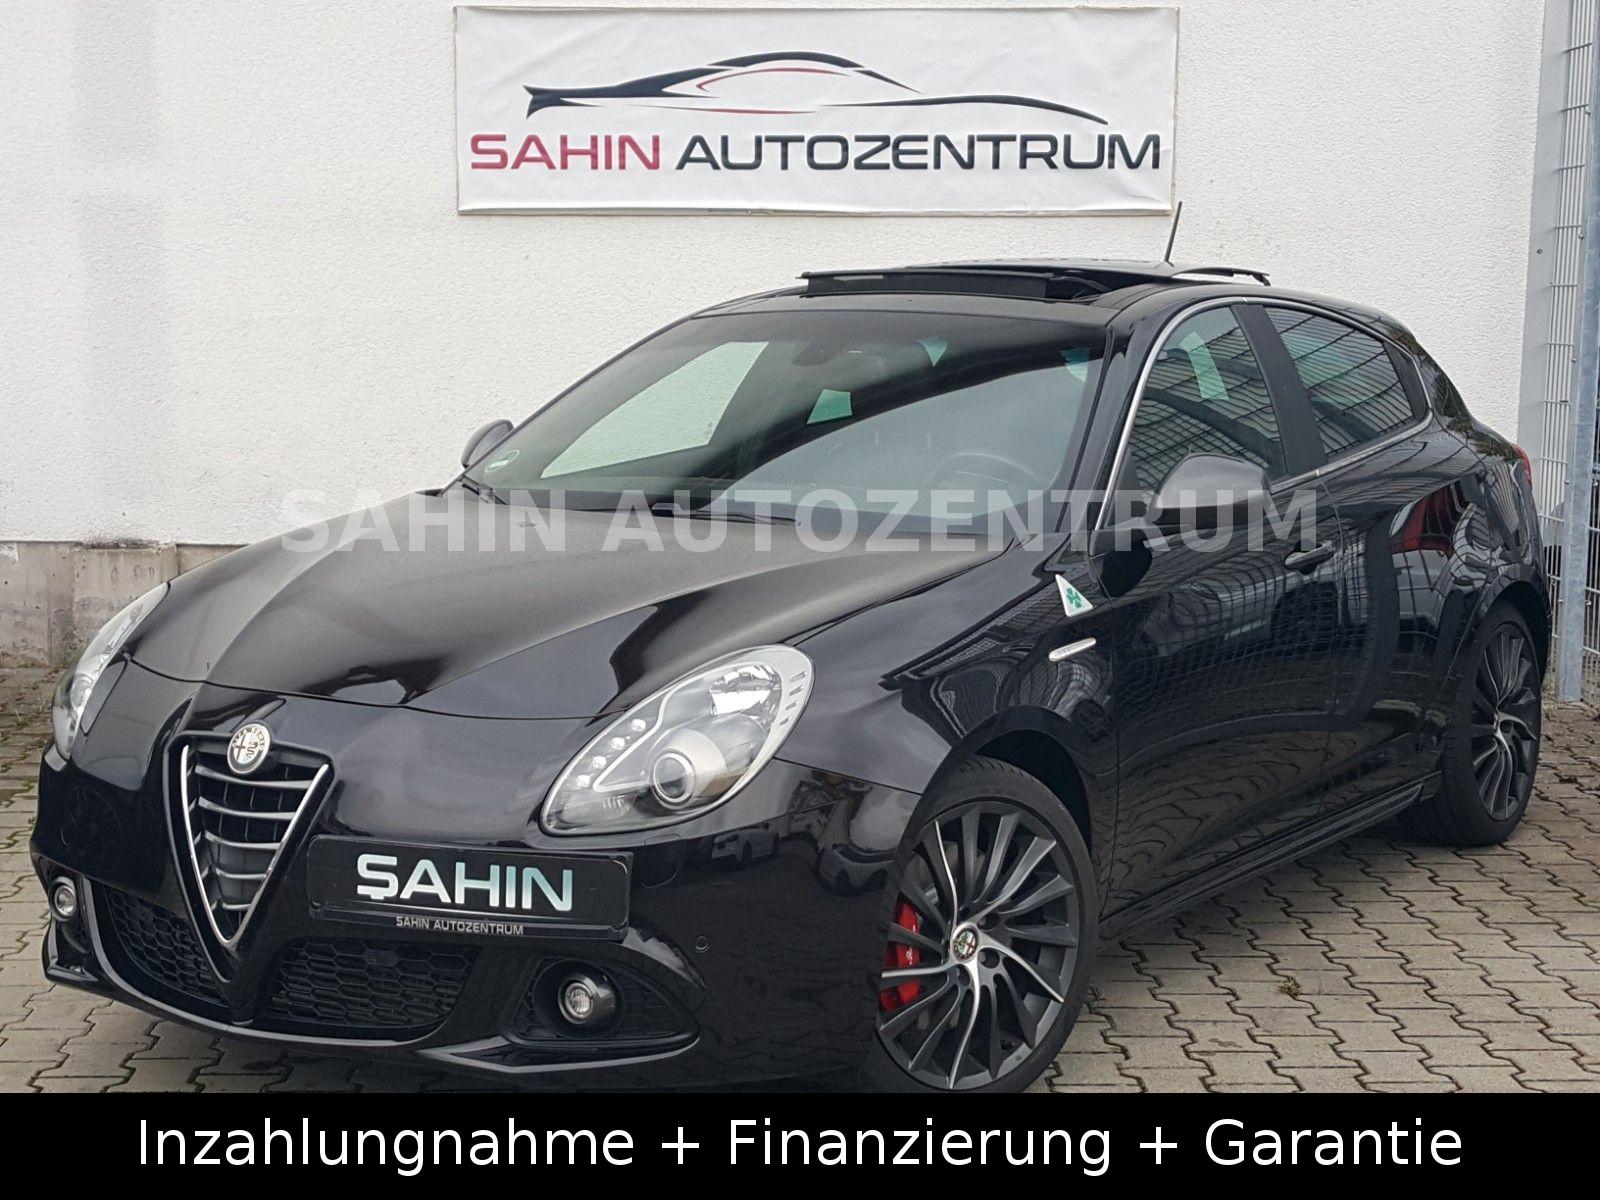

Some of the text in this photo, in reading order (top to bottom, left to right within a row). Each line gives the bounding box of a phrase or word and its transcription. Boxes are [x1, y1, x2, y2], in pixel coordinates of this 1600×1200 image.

[470, 133, 1161, 171] SAHIN AUTOZENTRUM
[395, 915, 524, 936] SAHIN AUTOZENTRUM
